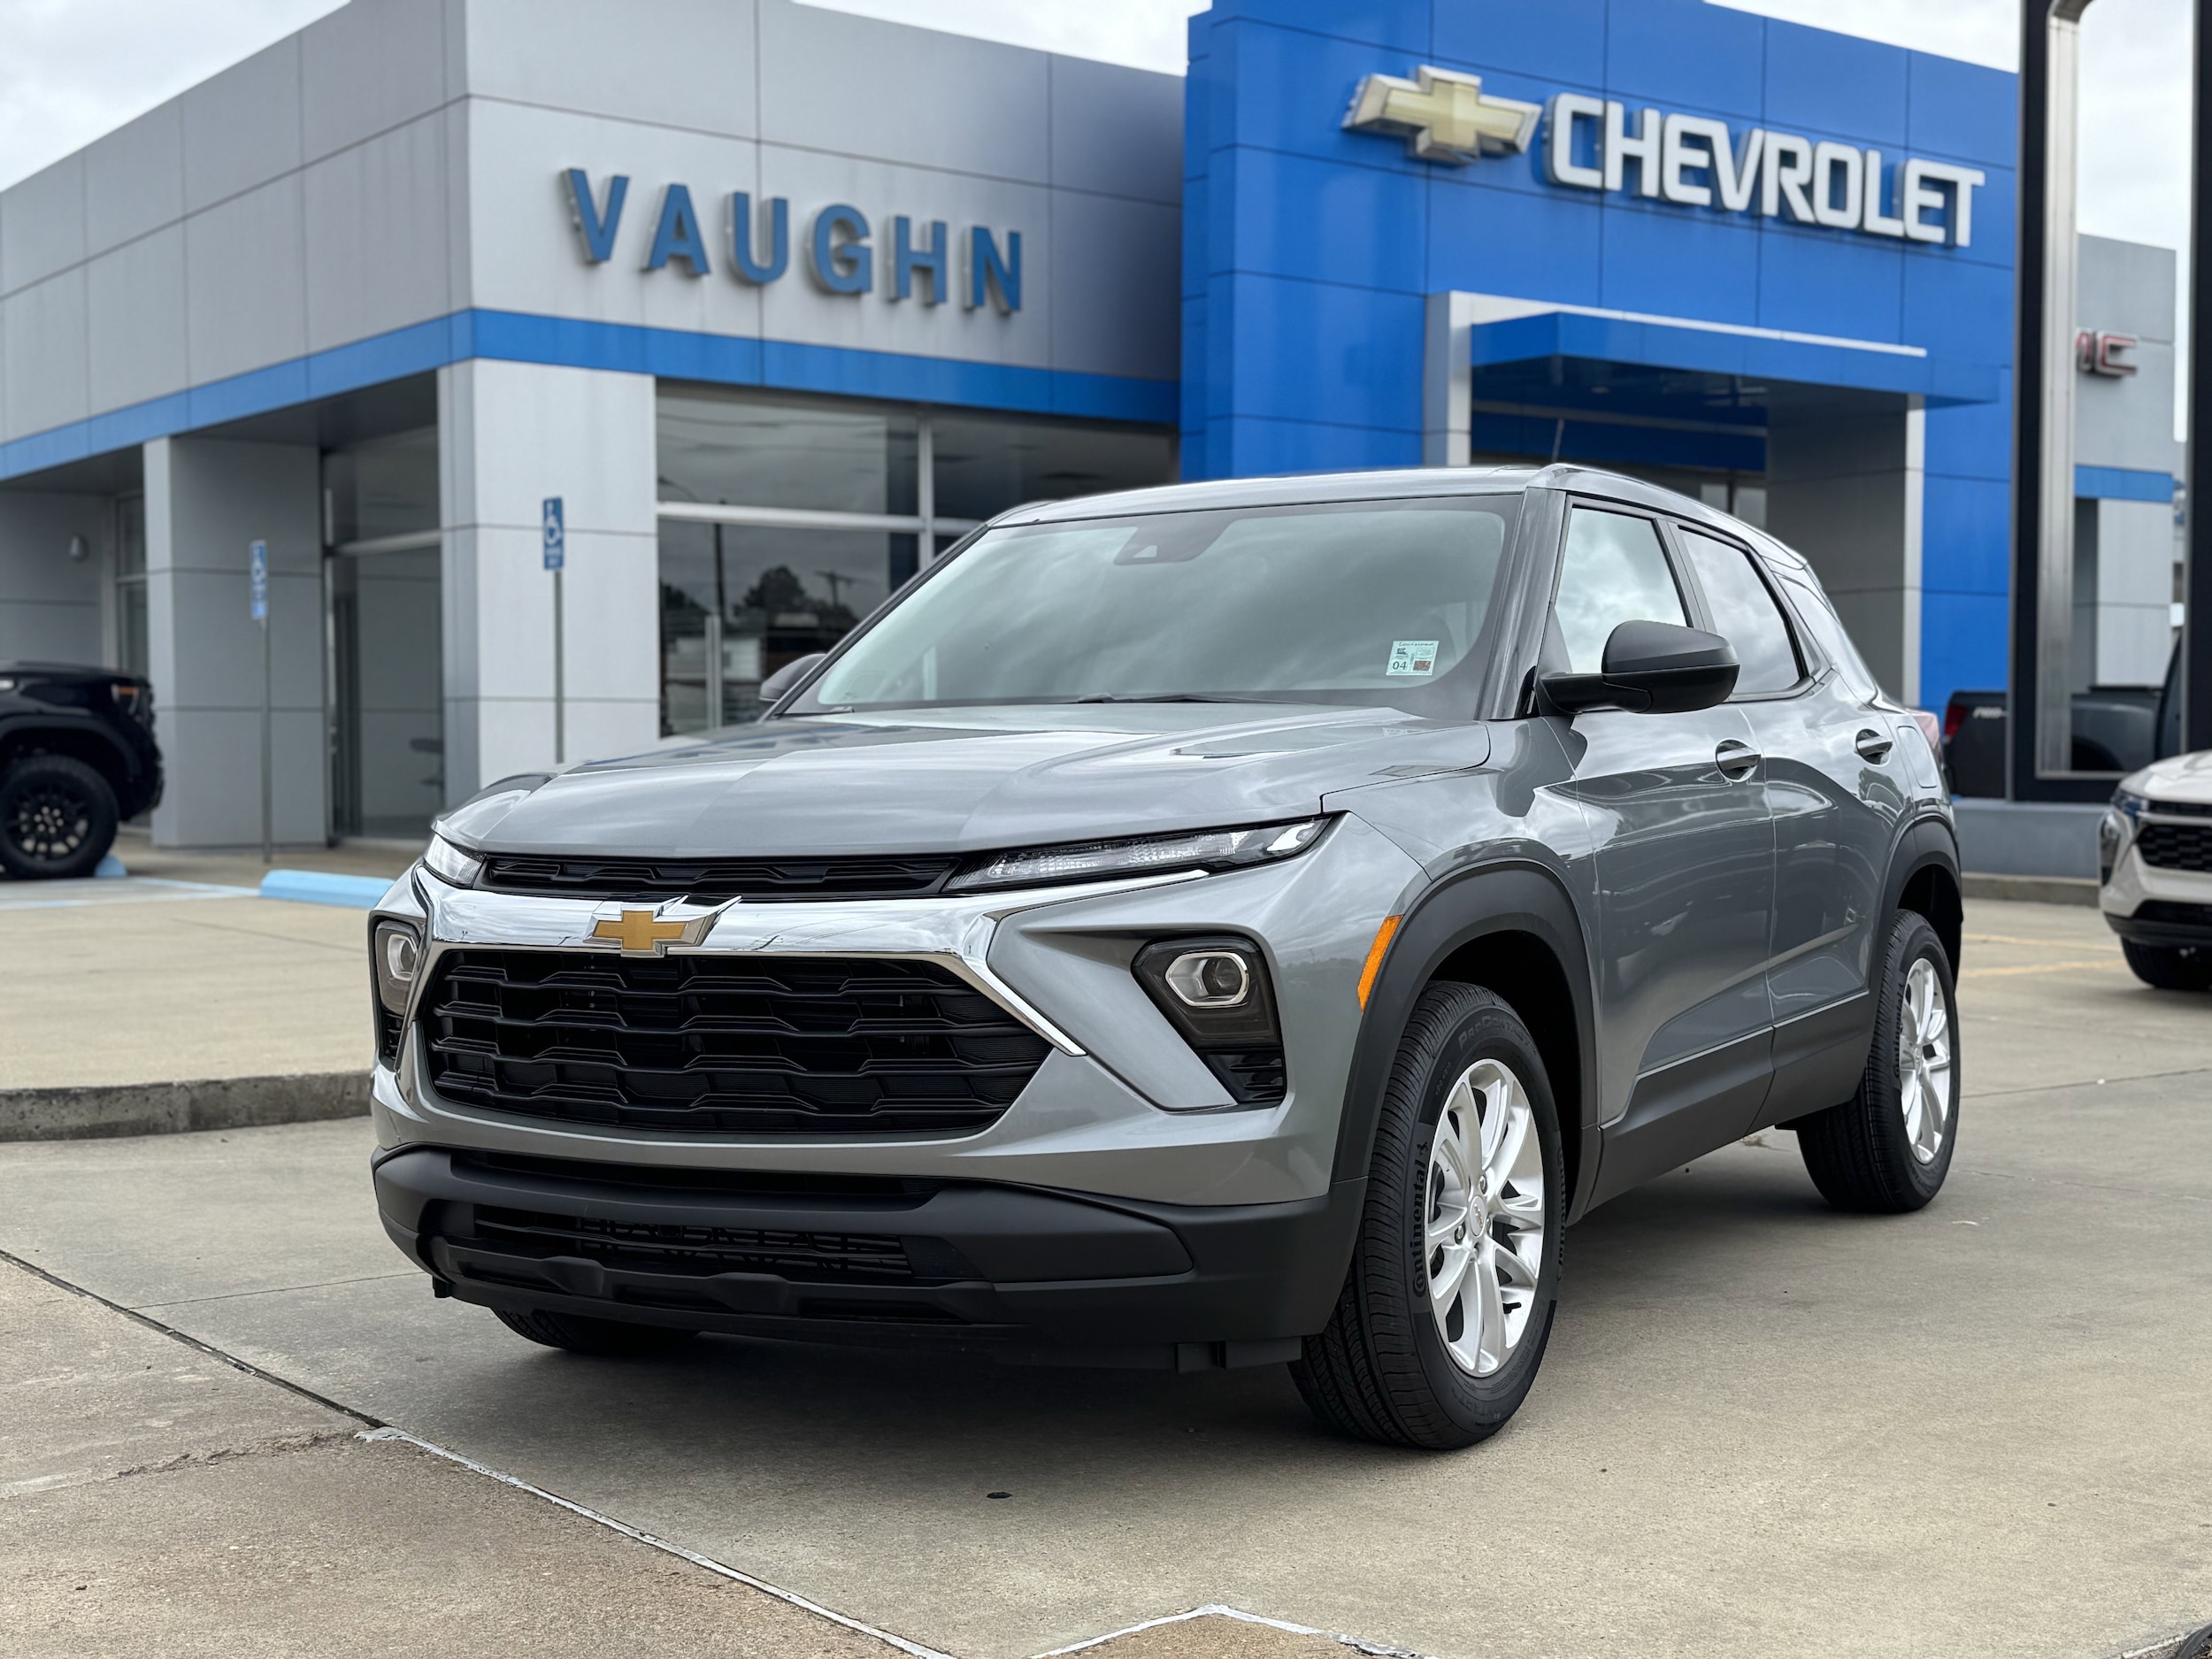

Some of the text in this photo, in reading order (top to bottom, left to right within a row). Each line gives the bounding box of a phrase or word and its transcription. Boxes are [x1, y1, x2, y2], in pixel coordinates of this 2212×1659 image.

[561, 167, 1022, 313] VAUGHN
[1544, 91, 1985, 248] CHEVROLET
[1392, 661, 1407, 671] 04
[1409, 1159, 1427, 1298] Continental
